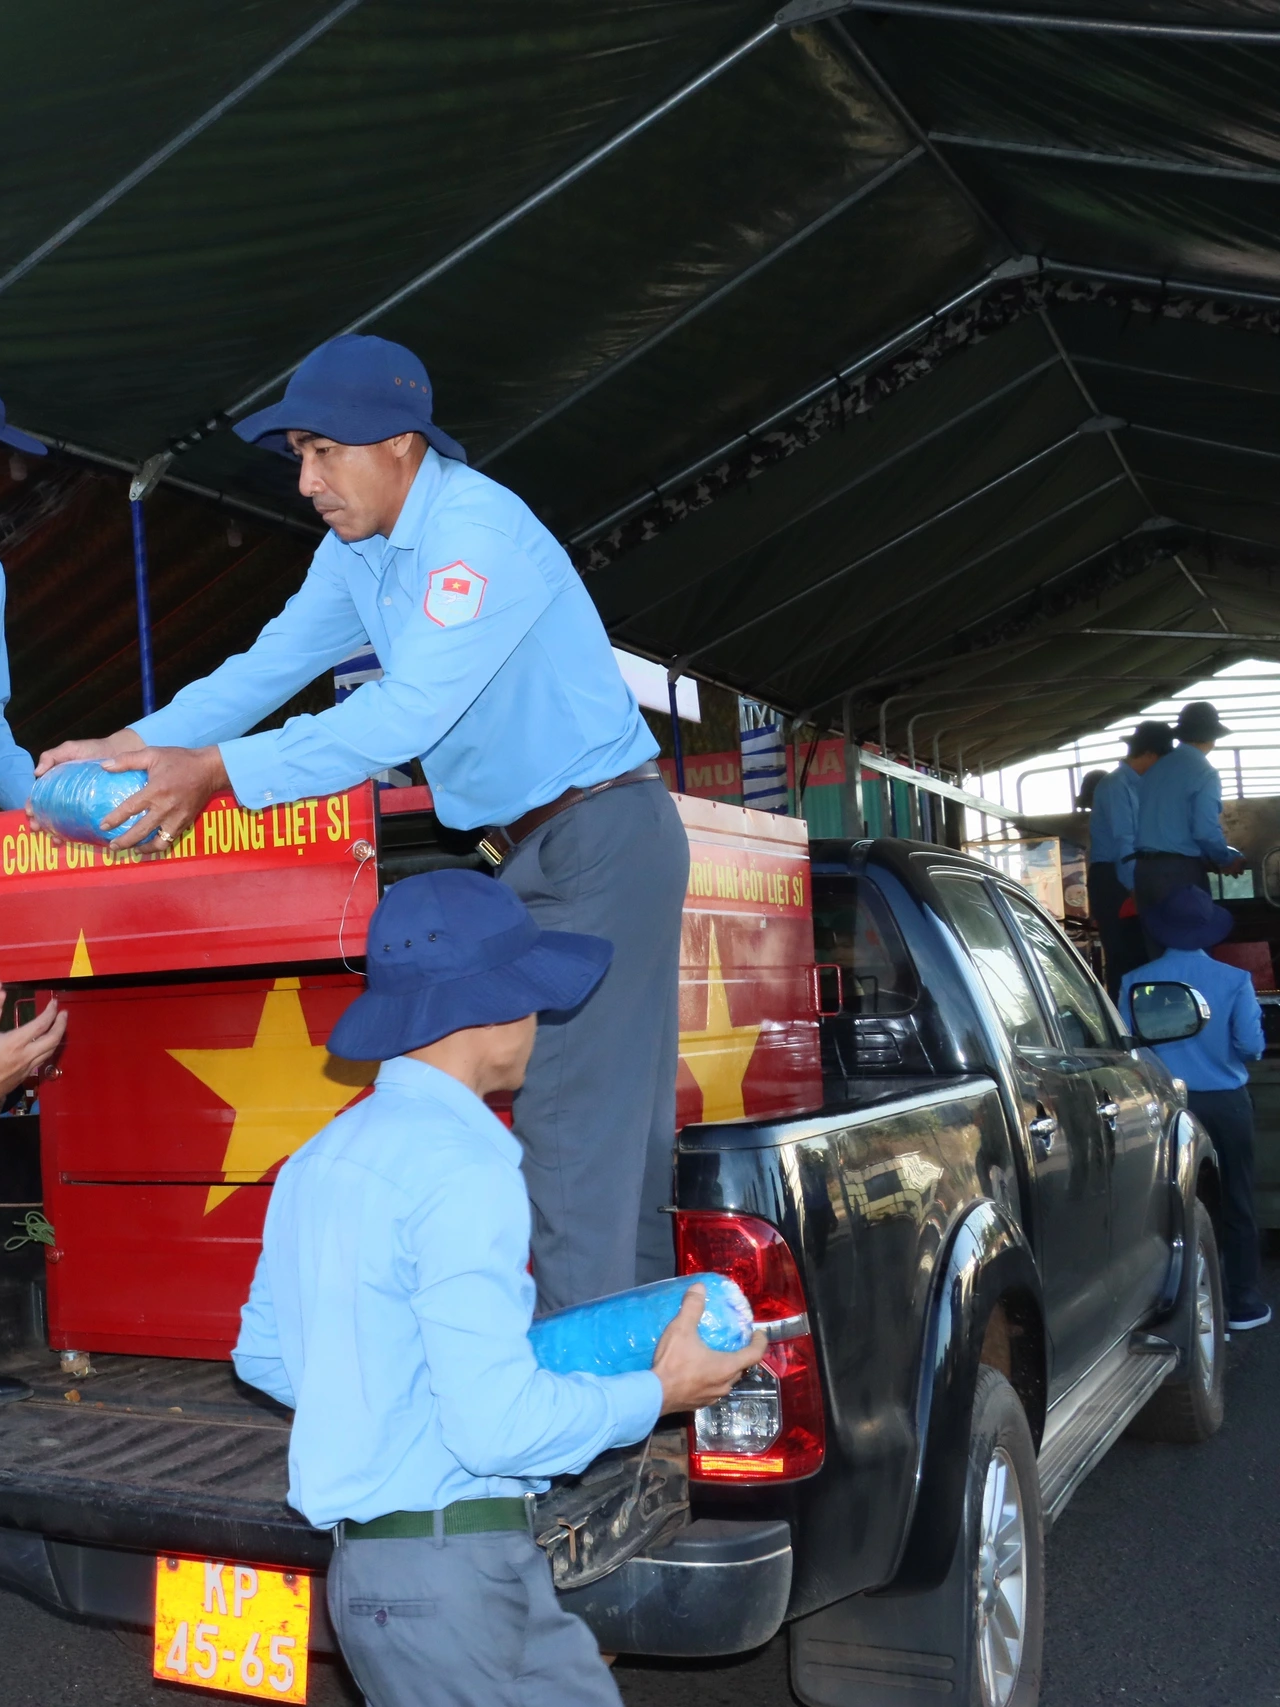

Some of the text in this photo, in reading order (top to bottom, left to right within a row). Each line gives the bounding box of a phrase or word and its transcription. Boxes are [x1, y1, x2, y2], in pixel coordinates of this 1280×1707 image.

[3, 824, 59, 876] CÔNG
[203, 799, 265, 855] HÙNG
[272, 798, 318, 856] LIỆT
[742, 858, 764, 902] CỐT
[767, 868, 790, 911] LIỆT
[793, 871, 804, 907] SĨ
[204, 1560, 259, 1618] KP
[165, 1621, 296, 1693] 45-65
